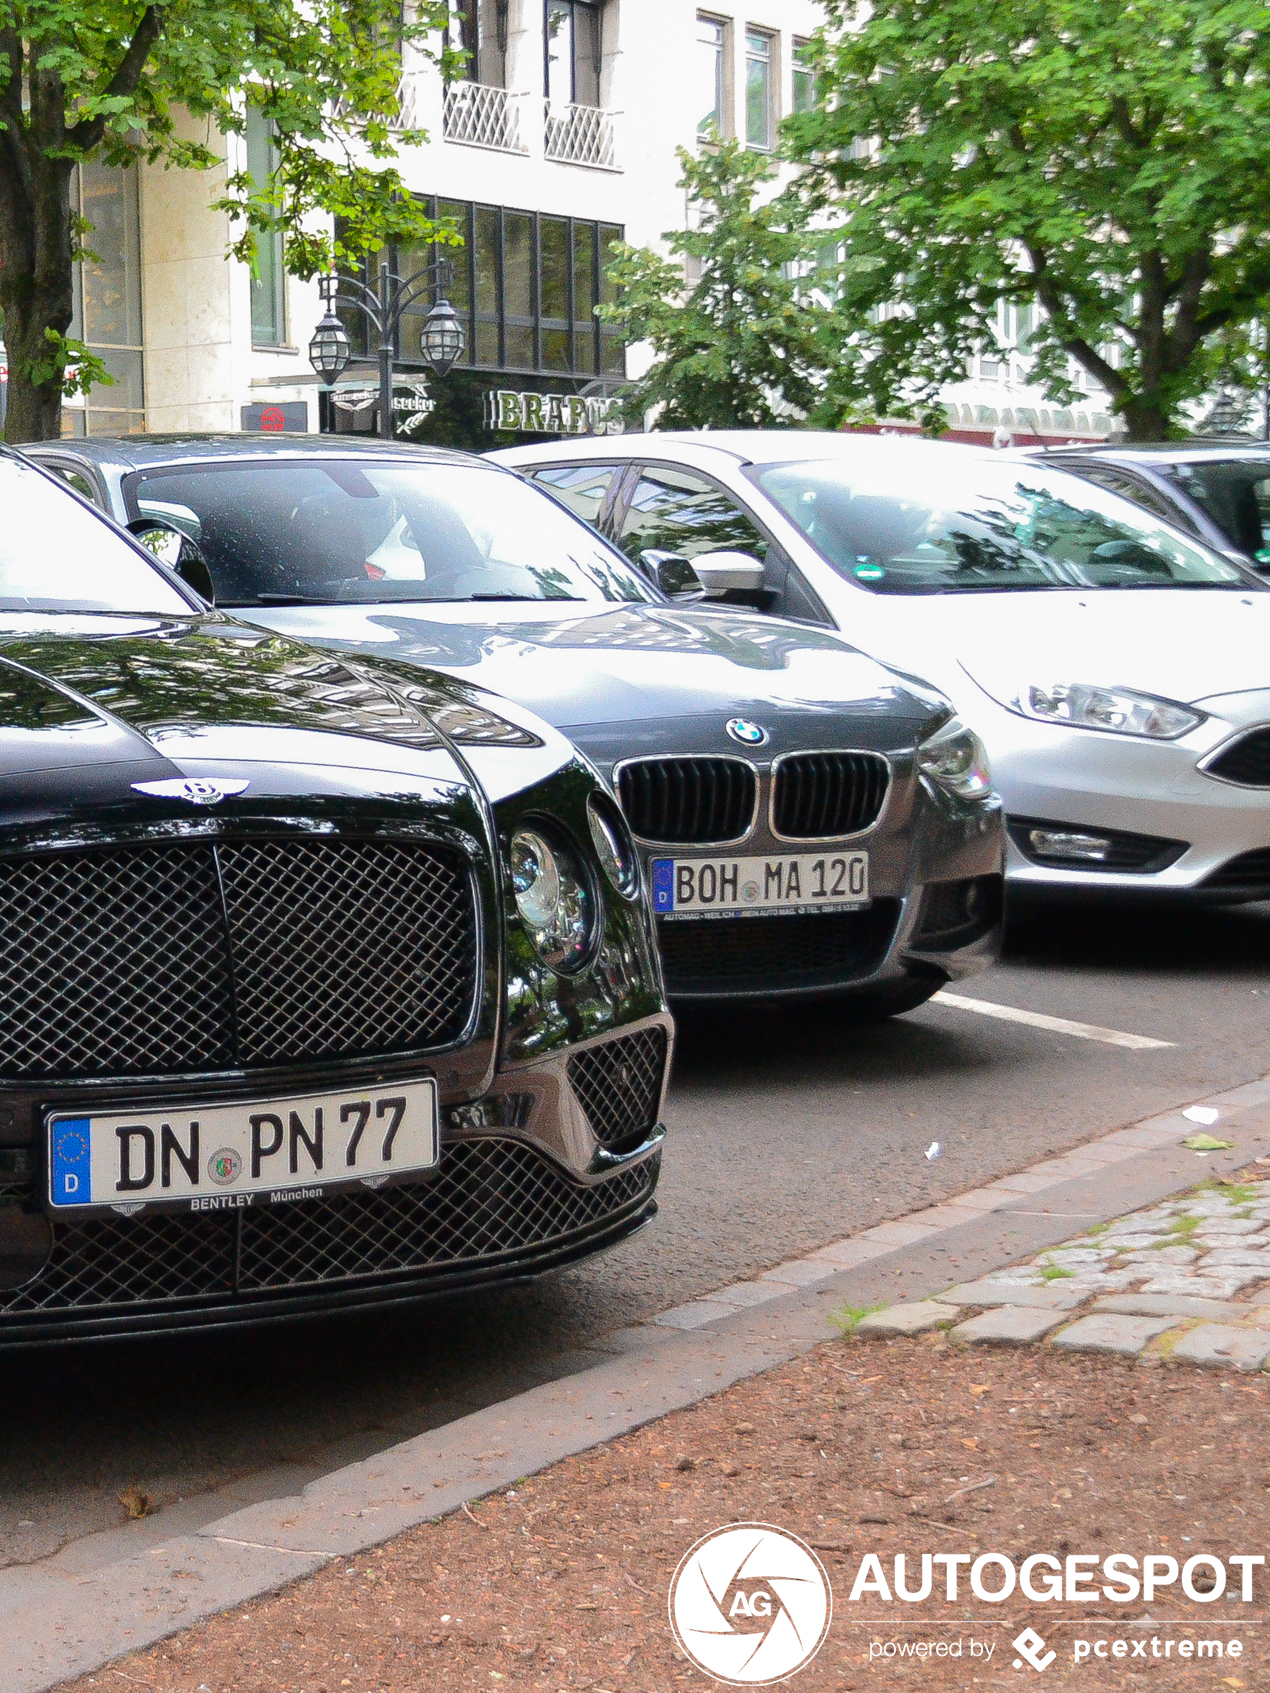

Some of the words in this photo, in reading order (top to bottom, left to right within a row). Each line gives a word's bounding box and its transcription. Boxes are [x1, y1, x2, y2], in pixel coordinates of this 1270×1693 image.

[497, 389, 625, 435] BRABUS
[676, 863, 738, 904] BOH
[764, 860, 801, 900] MA
[811, 857, 864, 898] 120
[114, 1121, 200, 1192] DN
[249, 1106, 323, 1179] PN
[340, 1096, 407, 1167] 77
[64, 1173, 79, 1194] D
[190, 1193, 255, 1211] BENTLEY
[270, 1186, 323, 1203] München
